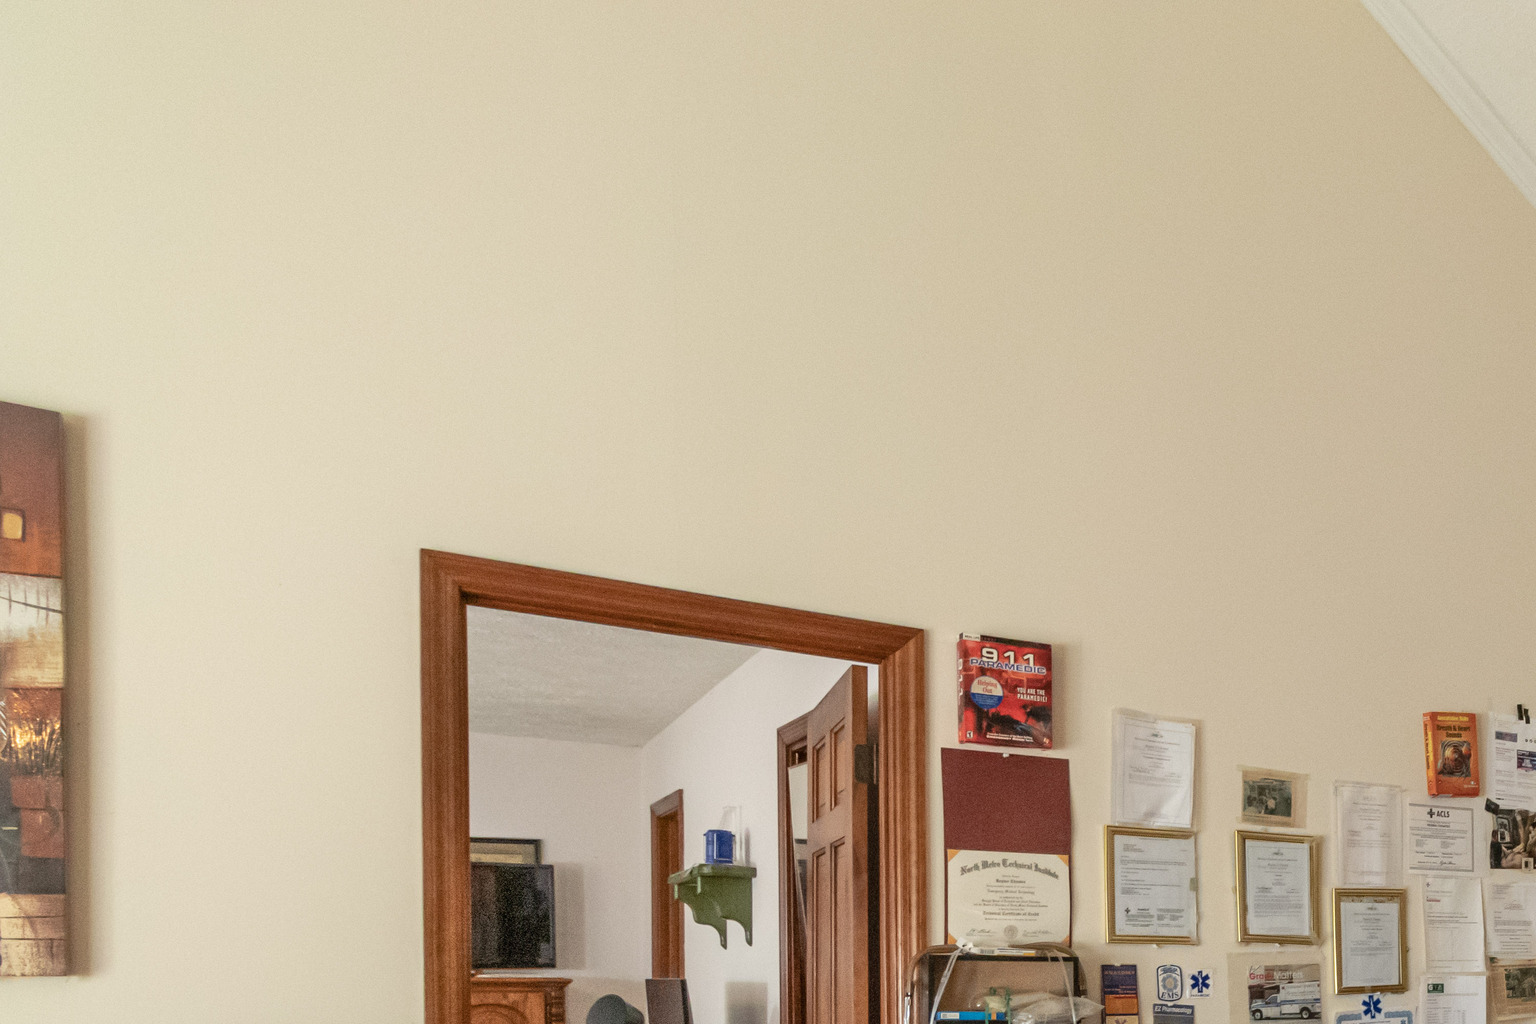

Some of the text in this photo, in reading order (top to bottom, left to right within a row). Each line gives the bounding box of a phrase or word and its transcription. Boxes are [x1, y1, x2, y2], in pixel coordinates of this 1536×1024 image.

[981, 647, 1035, 666] 911
[970, 658, 1046, 674] PARAMEDIC
[1436, 810, 1450, 818] ACLS
[960, 858, 1059, 880] North Metro Technical Institute
[1161, 991, 1179, 999] EMS
